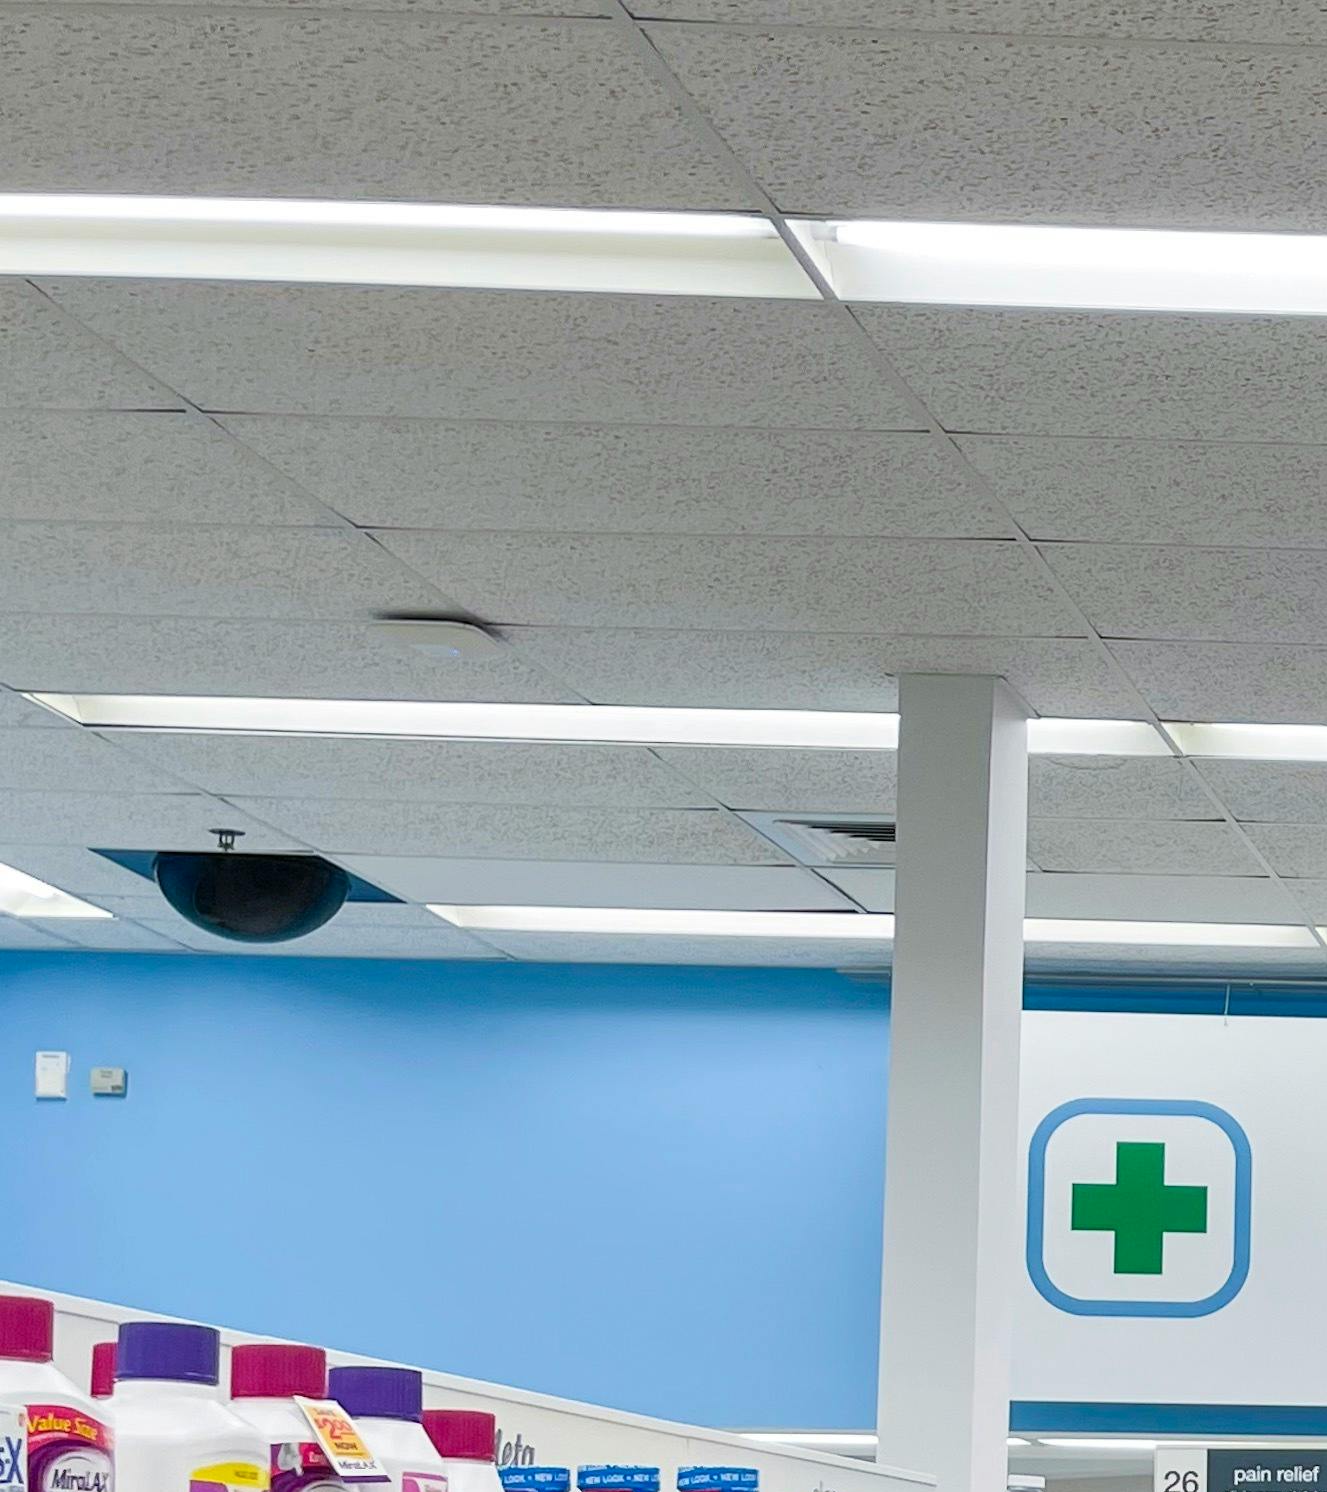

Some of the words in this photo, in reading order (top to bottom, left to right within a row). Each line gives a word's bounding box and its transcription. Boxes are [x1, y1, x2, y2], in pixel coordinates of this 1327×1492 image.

[51, 1468, 109, 1492] MiraLAX
[1234, 1466, 1272, 1485] pain
[1276, 1464, 1319, 1483] relief
